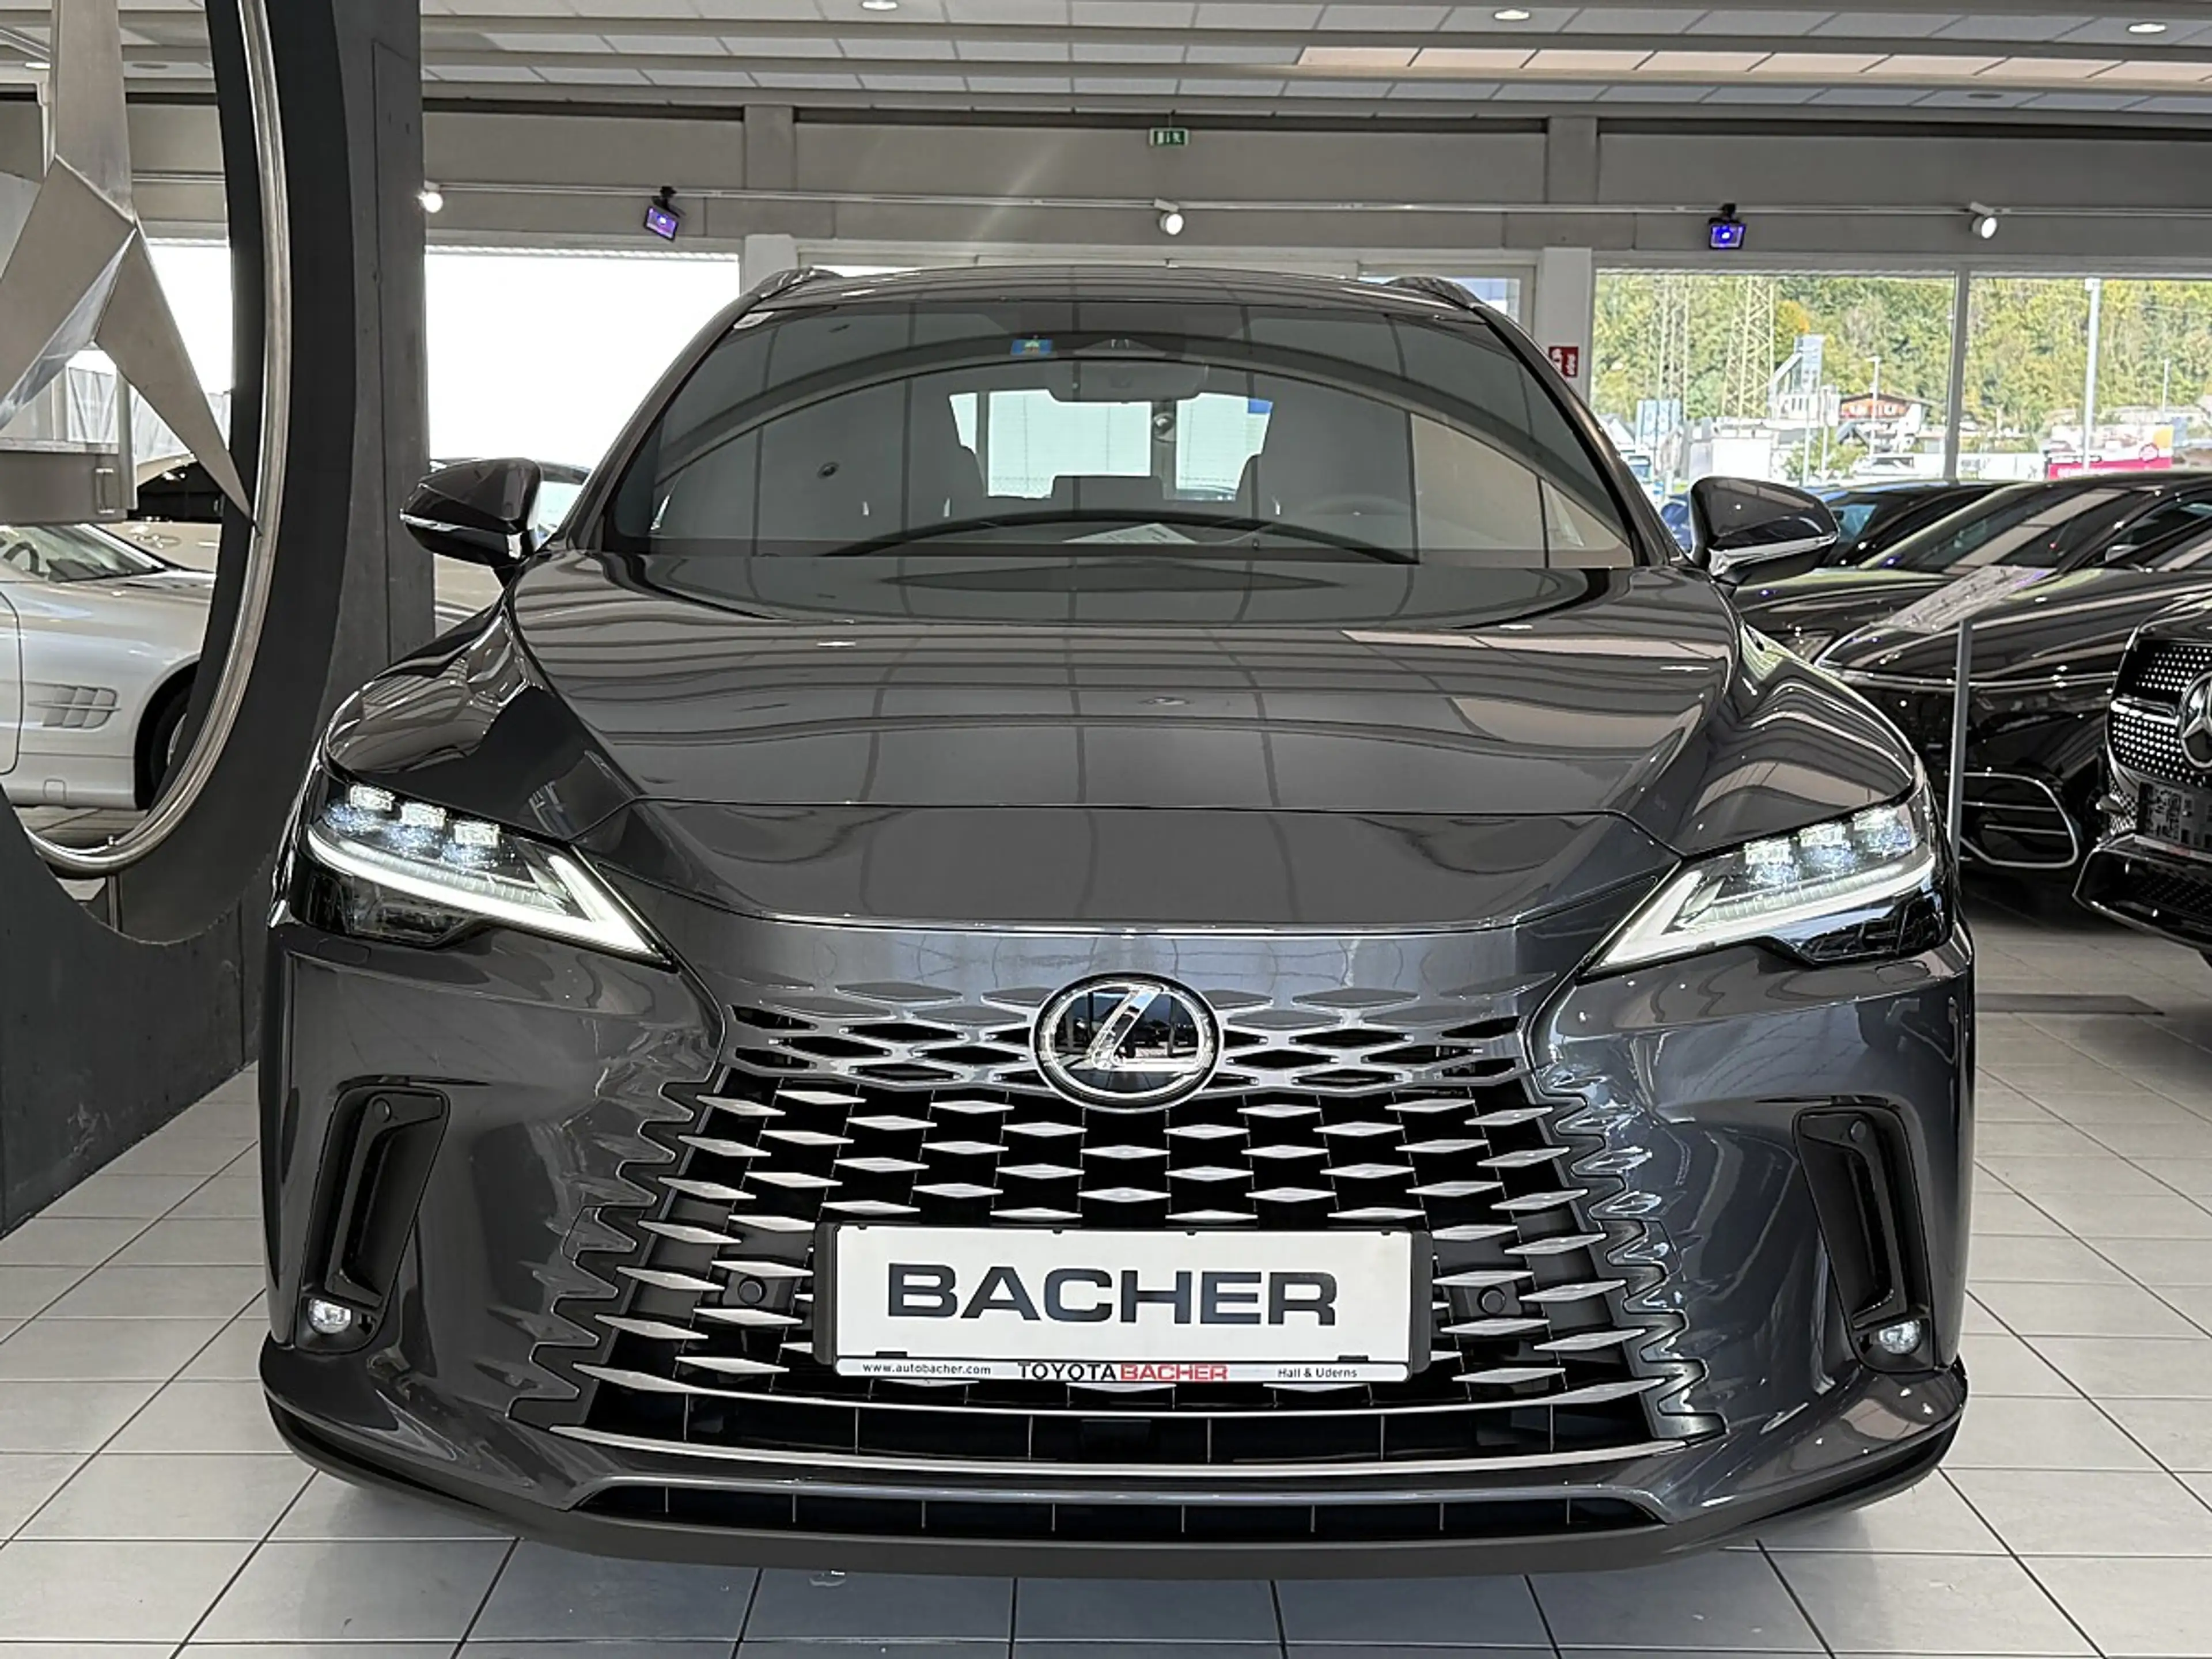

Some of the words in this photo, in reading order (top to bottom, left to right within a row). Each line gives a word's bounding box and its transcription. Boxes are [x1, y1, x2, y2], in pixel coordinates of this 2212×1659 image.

[888, 1263, 1337, 1326] BACHER
[862, 1363, 991, 1375] www.autobacher.com
[1277, 1368, 1301, 1378] Hall
[1304, 1367, 1313, 1378] &
